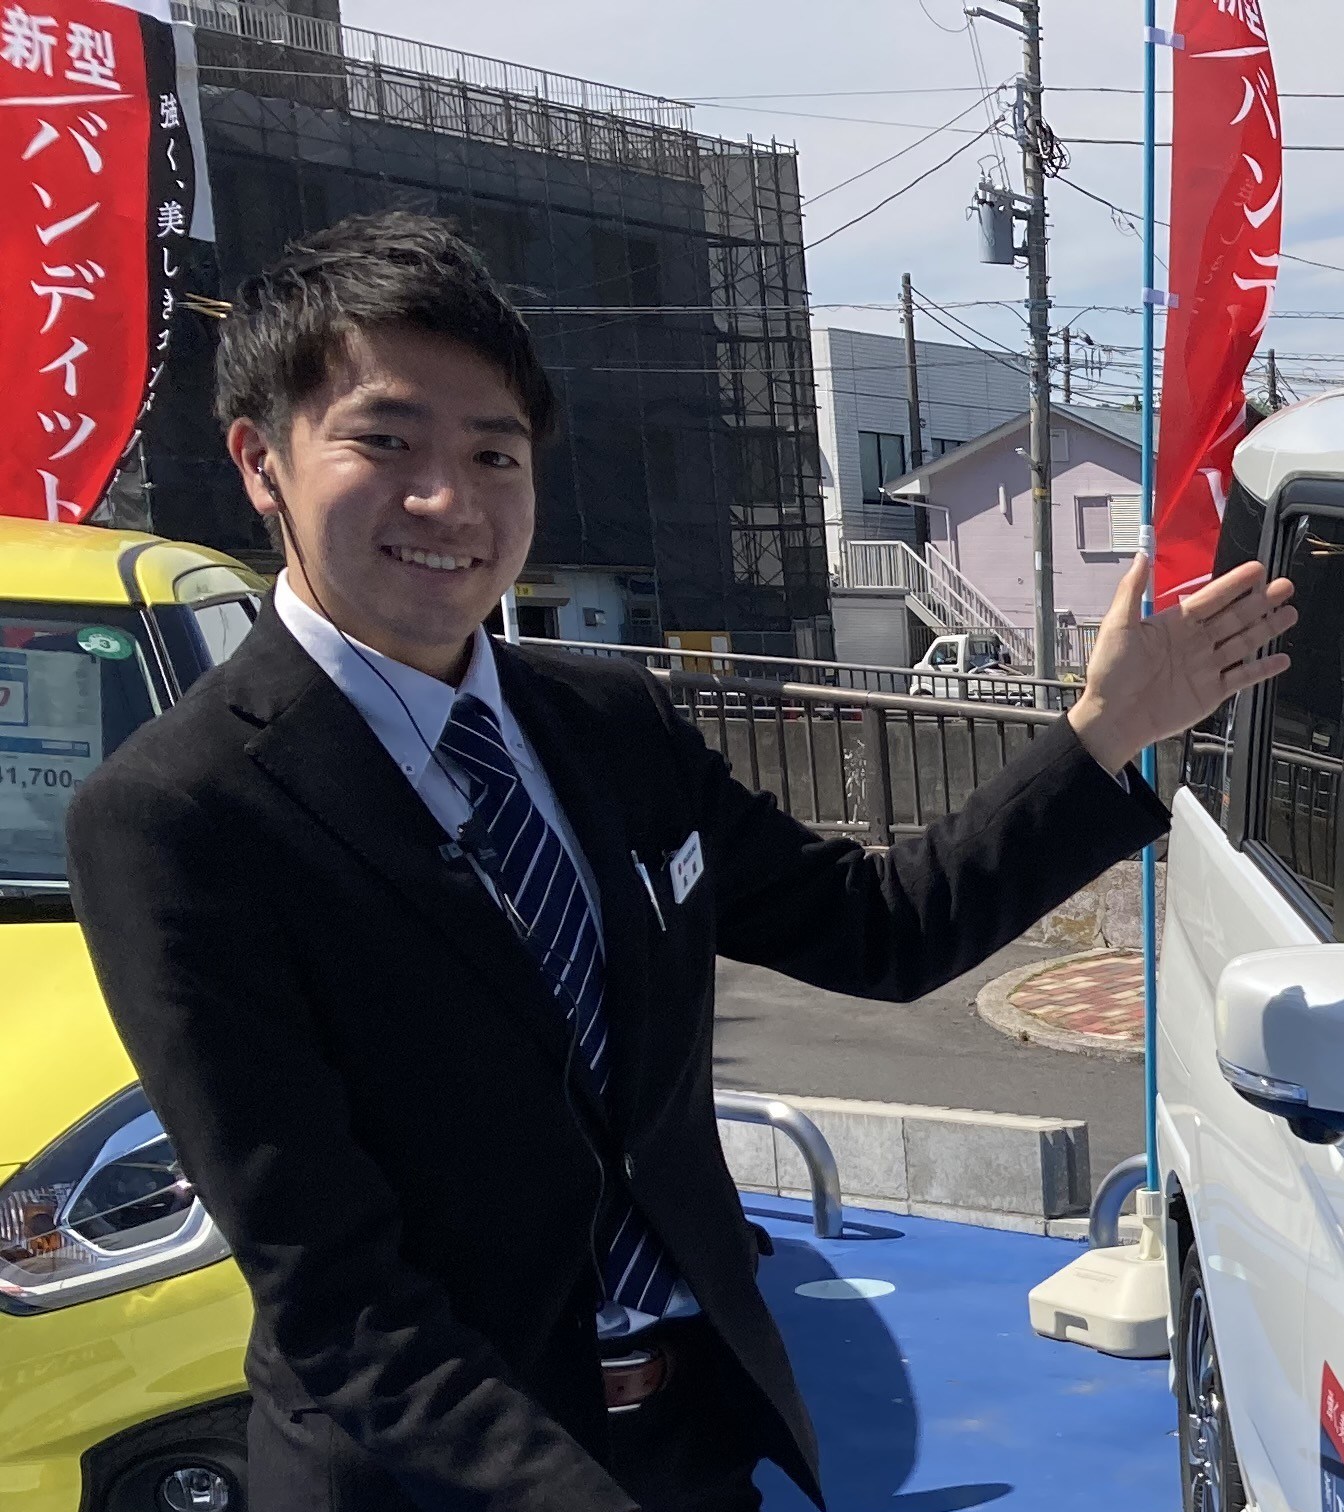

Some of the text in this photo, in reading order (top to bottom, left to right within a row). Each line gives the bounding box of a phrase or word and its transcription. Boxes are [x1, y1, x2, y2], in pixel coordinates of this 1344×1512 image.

[0, 4, 121, 91] 新型
[21, 109, 108, 523] バンディット
